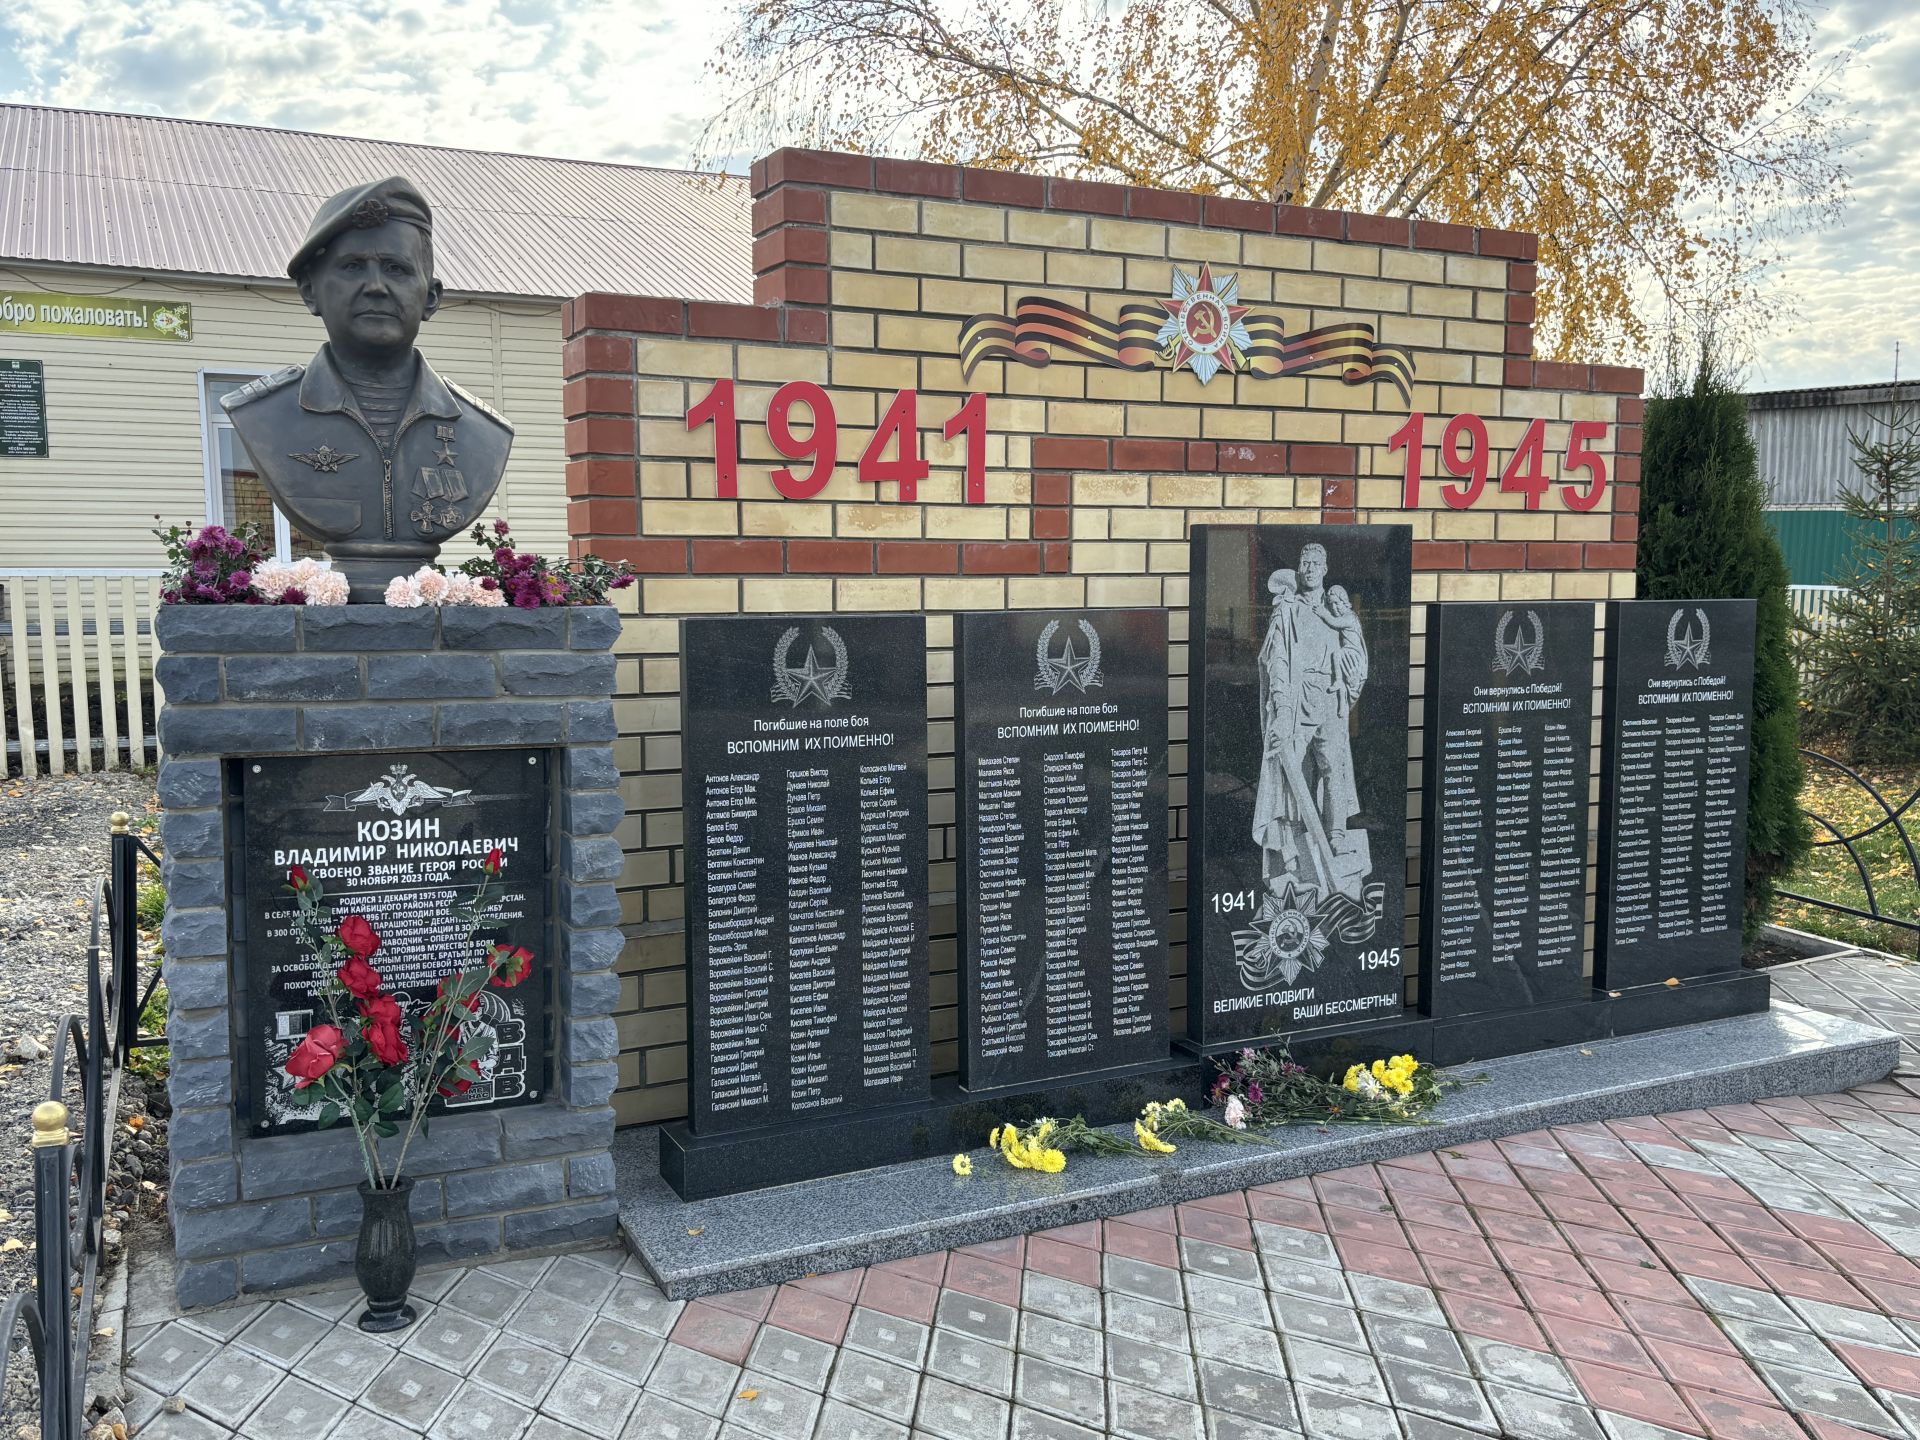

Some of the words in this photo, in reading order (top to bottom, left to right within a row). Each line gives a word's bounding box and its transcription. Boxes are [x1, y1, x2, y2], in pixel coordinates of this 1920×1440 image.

[0, 296, 35, 326] бро
[41, 305, 148, 328] пожаловать!
[687, 379, 986, 504] 1941
[1388, 412, 1607, 511] 1945
[1648, 679, 1660, 688] Они
[1661, 678, 1692, 689] вернулись
[1698, 676, 1725, 686] Победой!
[1474, 686, 1488, 696] Они
[1489, 685, 1524, 698] вернулись
[1531, 683, 1562, 693] Победой!
[1639, 693, 1679, 704] ВСПОМНИМ
[1682, 692, 1692, 702] ИХ
[1692, 690, 1733, 702] ПОИМЕННО!
[1020, 706, 1065, 718] Погибшие
[1067, 707, 1078, 716] на
[1079, 706, 1100, 715] поле
[1102, 703, 1118, 713] боя
[1463, 701, 1509, 713] ВСПОМНИМ
[1513, 701, 1523, 711] ИХ
[1524, 699, 1571, 711] ПОИМЕННО!
[754, 719, 807, 732] Погибшие
[810, 719, 822, 729] на
[824, 717, 849, 728] поле
[851, 715, 869, 727] боя
[998, 724, 1058, 738] ВСПОМНИМ
[1063, 723, 1077, 734] ИХ
[1079, 720, 1139, 734] ПОИМЕННО!
[728, 739, 799, 754] ВСПОМНИМ
[805, 738, 821, 750] ИХ
[823, 734, 894, 749] ПОИМЕННО!
[706, 775, 729, 783] Антонов
[730, 773, 760, 782] Александр
[787, 770, 809, 778] Горшков
[810, 768, 828, 777] Виктор
[706, 787, 729, 795] Антонов
[730, 785, 743, 794] Егор
[1067, 784, 1085, 793] Николай
[887, 809, 909, 818] Григорий
[358, 818, 440, 842] КОЗИН
[707, 824, 724, 832] Белов
[725, 823, 738, 832] Егор
[1007, 823, 1022, 831] Роман
[707, 836, 724, 844] Белов
[726, 835, 744, 844] Федор
[1005, 833, 1024, 842] Василий
[274, 845, 386, 867] ВЛАДИМИР
[396, 837, 518, 858] НИКОЛАЕВИЧ
[368, 863, 414, 876] ЗВАНИЕ
[420, 861, 455, 872] ГЕРОЯ
[462, 858, 507, 869] РОСИ
[733, 857, 764, 866] Константин
[788, 865, 808, 873] Иванов
[809, 863, 827, 872] Кузьма
[347, 878, 357, 886] 30
[360, 874, 398, 886] НОЯБРЯ
[401, 874, 422, 883] 2023
[425, 873, 451, 882] ГОДА.
[887, 880, 898, 888] Егор
[340, 896, 376, 906] РОДИЛСЯ
[384, 894, 417, 903] ДЕКАБРЯ
[1211, 890, 1255, 914] 1941
[351, 902, 402, 915] КАЙБИЦКОГО
[404, 901, 434, 909] РАЙОНА
[393, 909, 434, 919] ПРОХОДИЛ
[374, 919, 423, 929] ПАРАШЮТНО
[396, 925, 451, 936] МОБИЛИЗАЦИИ
[382, 936, 422, 947] НАВОДЧИК
[431, 934, 468, 942] ОПЕРАТОР
[391, 945, 425, 954] ПРОЯВИВ
[428, 941, 468, 950] МУЖЕСТВО
[369, 956, 401, 964] ВЕРНЫМ
[403, 953, 437, 962] ПРИСЯГЕ,
[1358, 948, 1399, 970] 1945
[374, 964, 420, 973] ЫПОЛНЕНИЯ
[422, 960, 451, 969] БОЕВОЙ
[396, 971, 437, 980] КЛАДБИЩЕ
[1214, 995, 1263, 1013] ВЕЛИКИЕ
[1266, 988, 1314, 1006] ПОДВИГИ
[1294, 1004, 1323, 1019] ВАШИ
[1325, 993, 1397, 1014] БЕССМЕРТНЫ!
[807, 1052, 821, 1060] Илья
